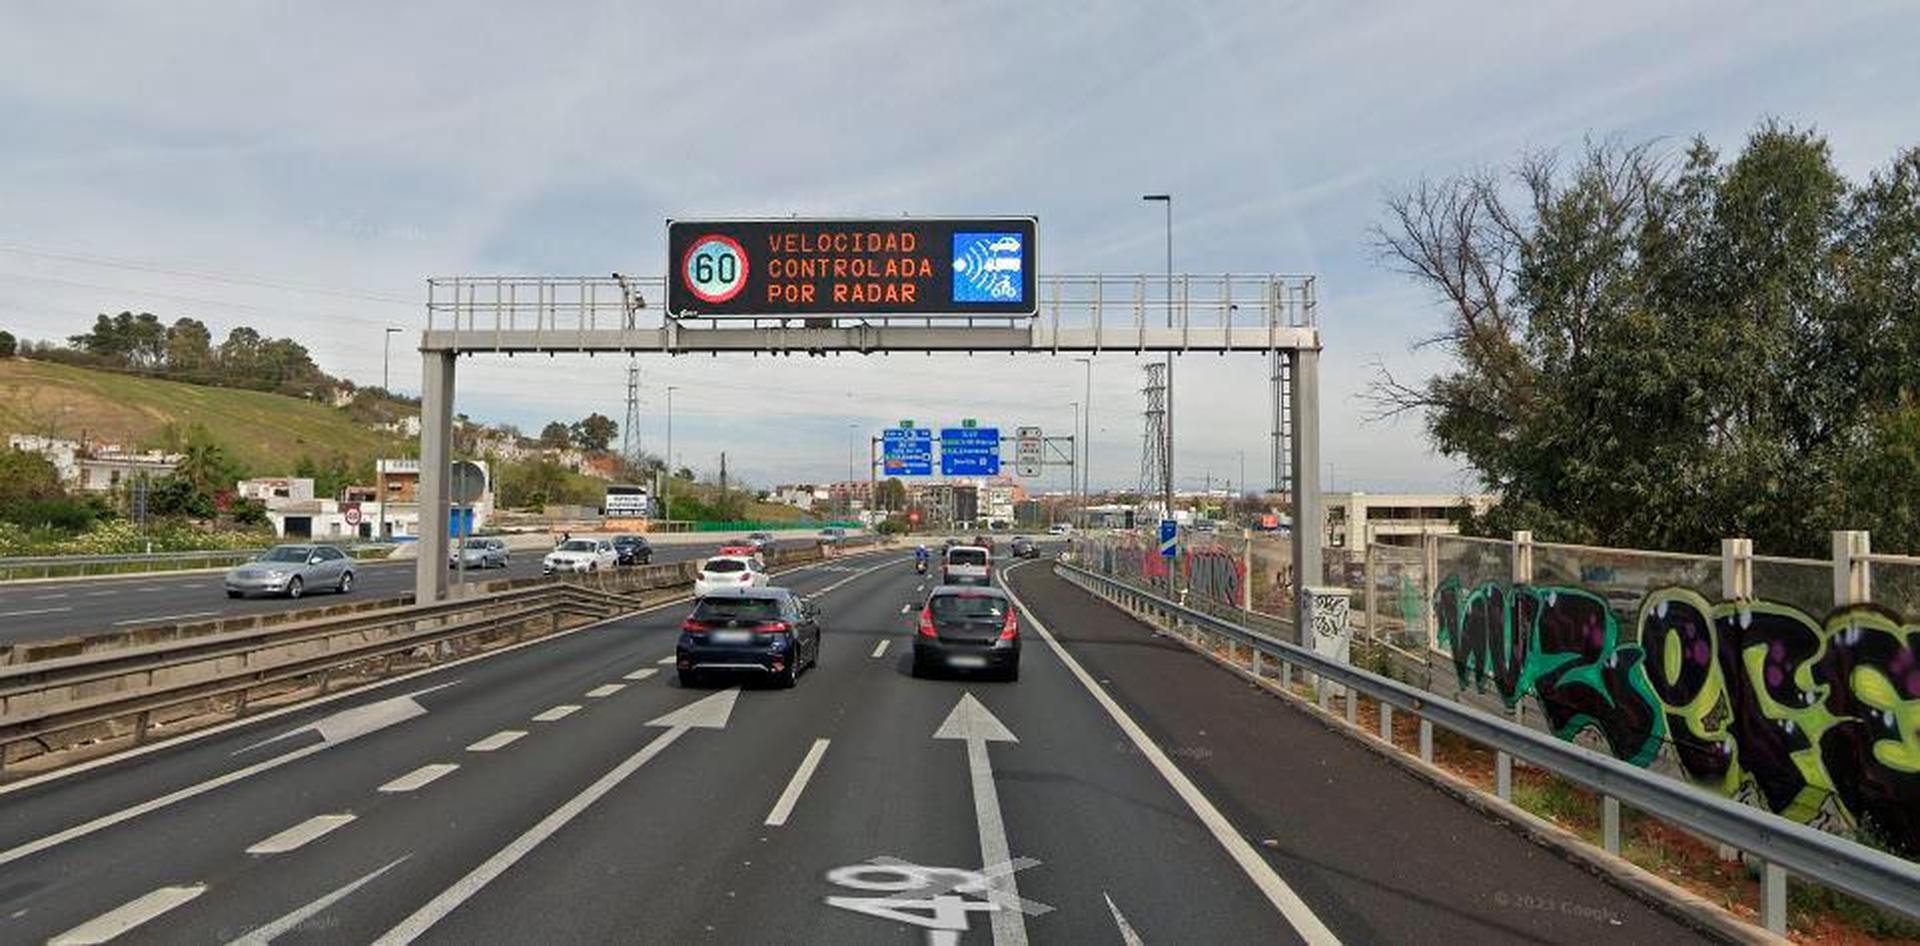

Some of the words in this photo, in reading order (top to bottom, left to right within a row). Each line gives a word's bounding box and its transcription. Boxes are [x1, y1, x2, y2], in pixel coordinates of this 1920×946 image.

[768, 233, 916, 252] VELOCIDAD
[695, 253, 736, 283] 60
[769, 258, 933, 278] CONTROLADA
[768, 283, 815, 303] POR
[833, 283, 916, 303] RADAR
